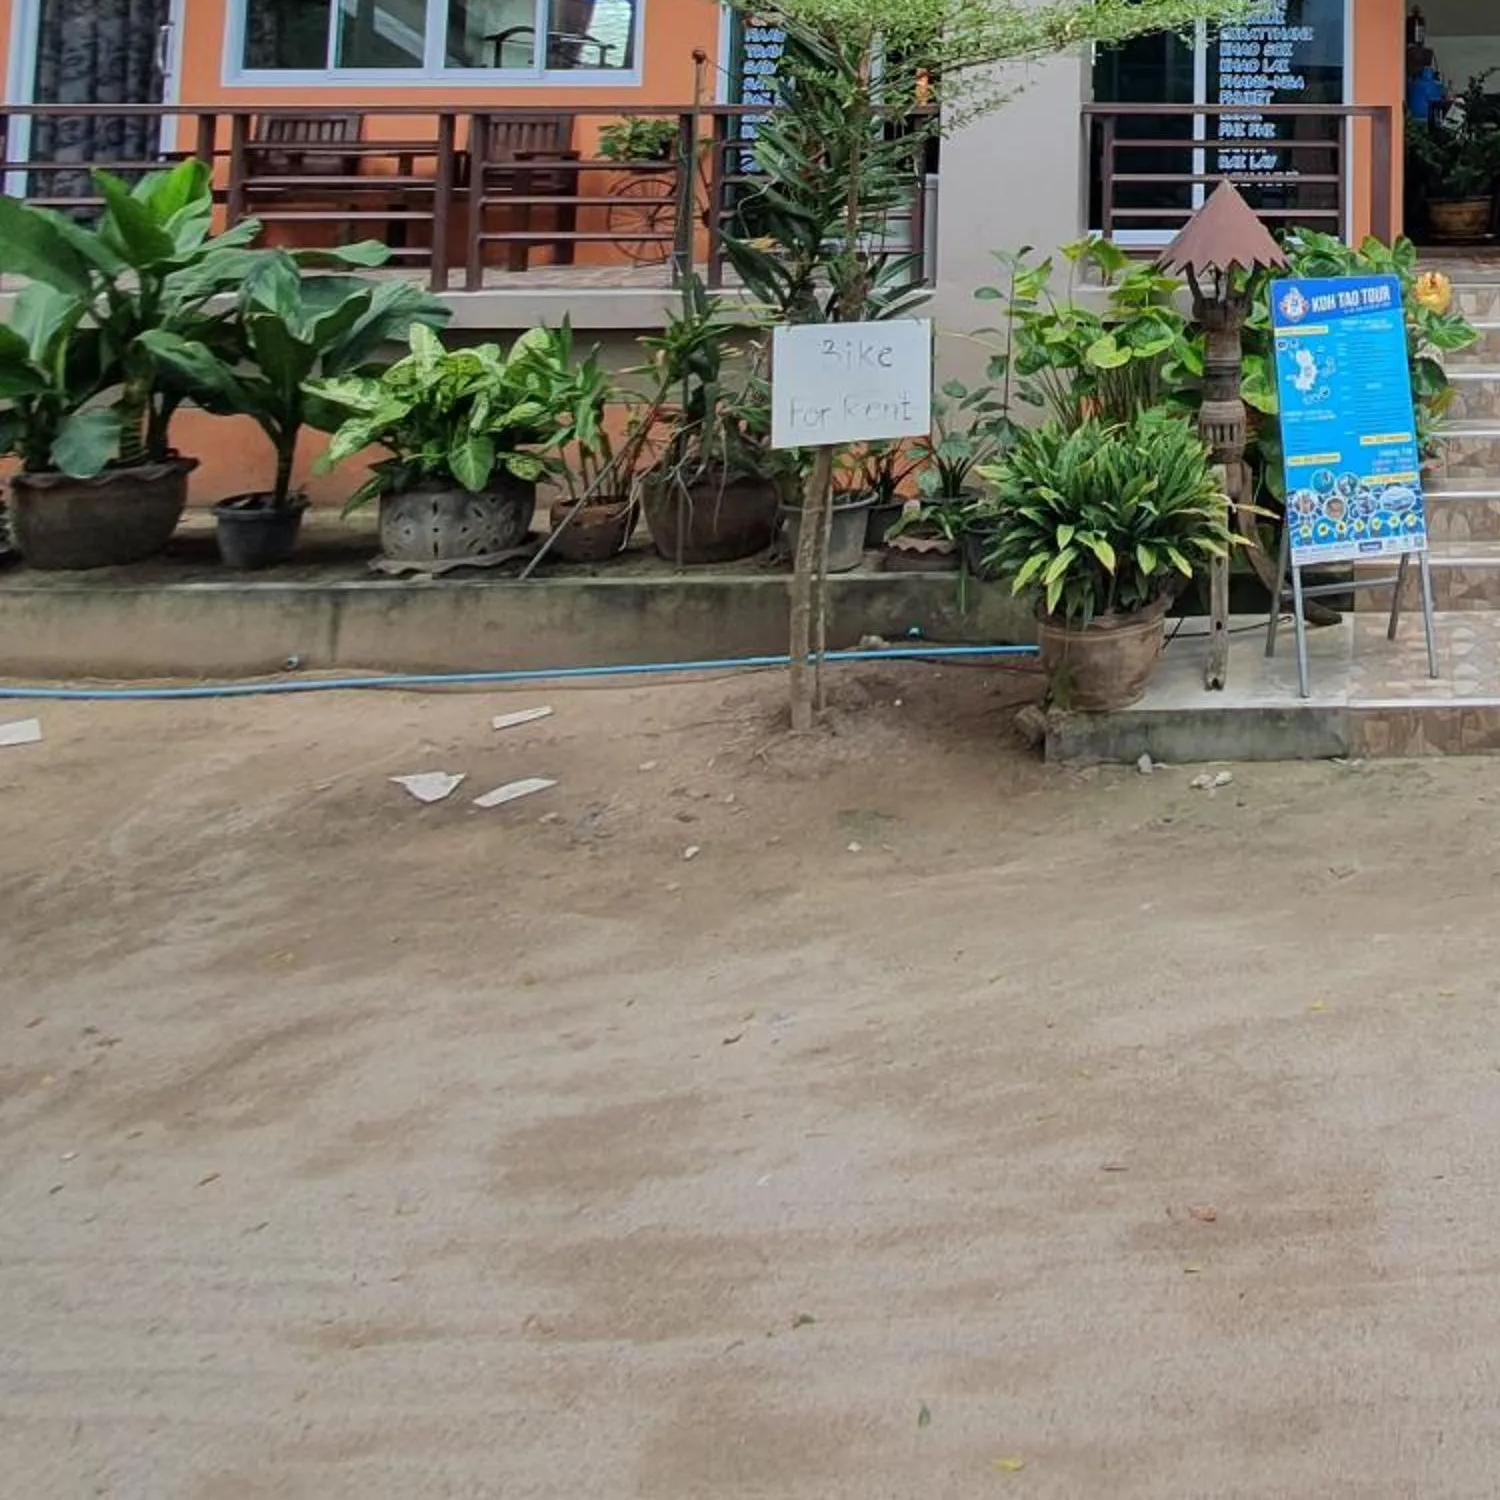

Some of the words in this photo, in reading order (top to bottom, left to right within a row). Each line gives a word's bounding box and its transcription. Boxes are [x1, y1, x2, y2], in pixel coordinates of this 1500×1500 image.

[1220, 42, 1260, 57] KHAO
[1263, 42, 1293, 57] SOK
[1220, 58, 1260, 72] KHAO
[1262, 58, 1290, 72] LAK
[1311, 293, 1336, 313] KOH
[1338, 289, 1360, 309] TAO
[1361, 285, 1391, 305] TOUR
